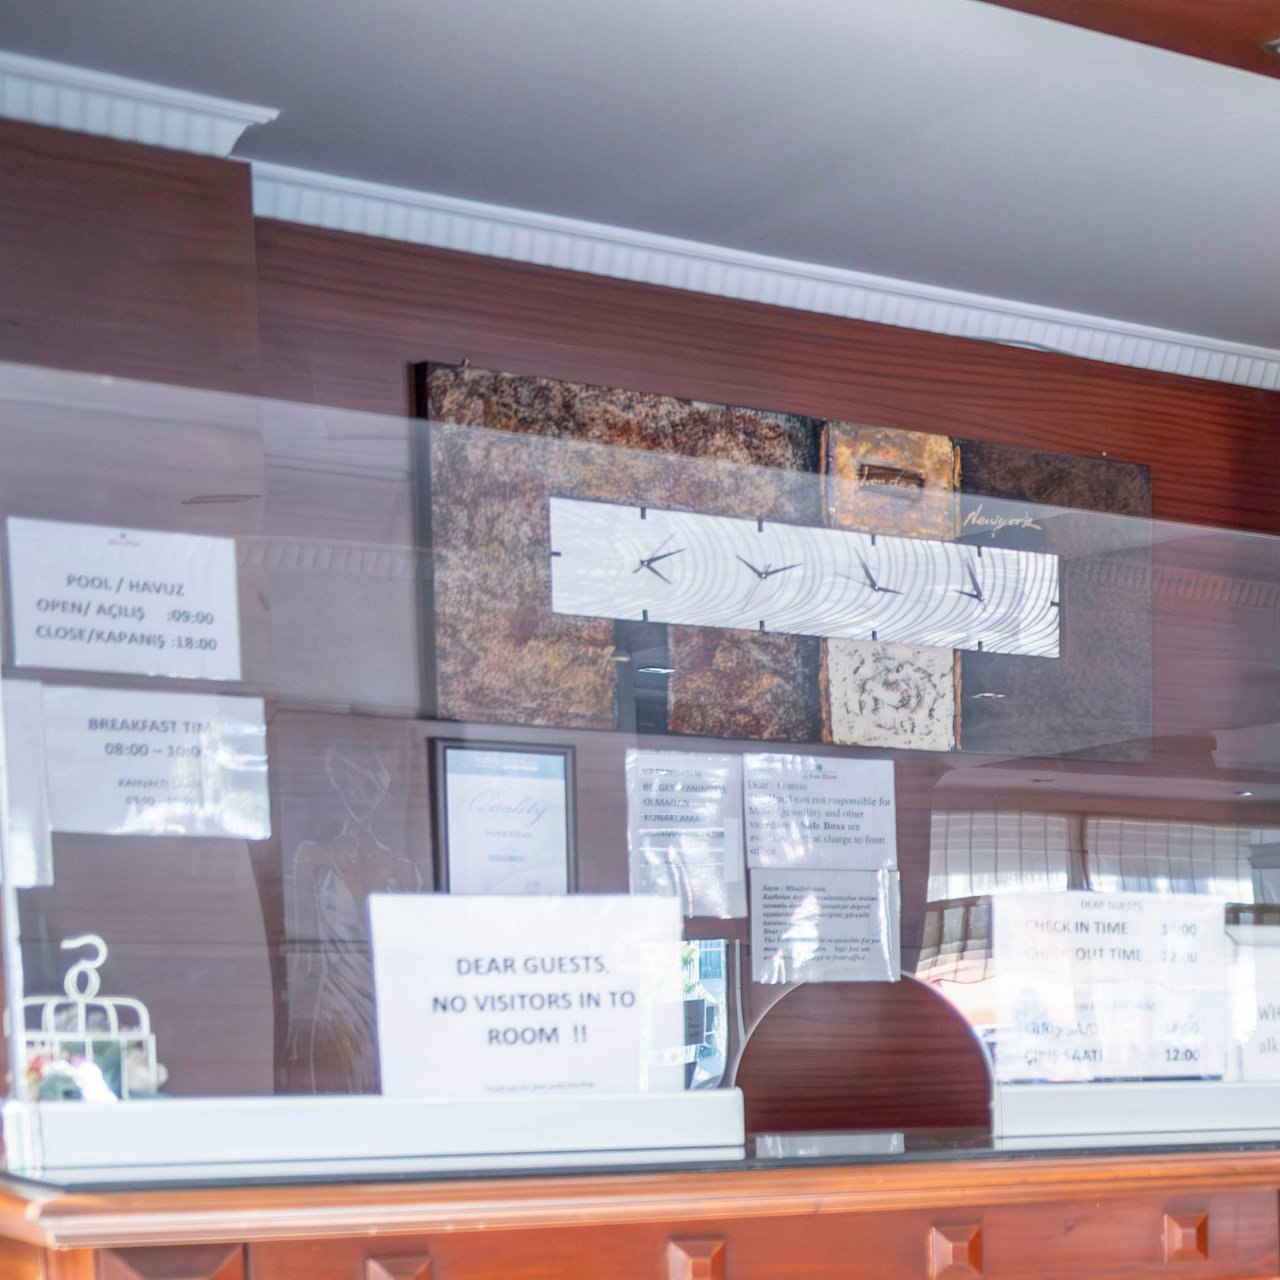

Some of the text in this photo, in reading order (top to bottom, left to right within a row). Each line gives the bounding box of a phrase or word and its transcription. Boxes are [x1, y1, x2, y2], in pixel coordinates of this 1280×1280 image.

[67, 574, 185, 596] POOL / HAVUZ
[36, 598, 215, 625] OPEN/ AÇILIŞ :09:00
[171, 636, 218, 651] :18:00
[88, 717, 177, 733] BREAKFAST
[104, 742, 149, 757] 08:00
[825, 808, 840, 818] and
[1075, 922, 1089, 934] IN
[1094, 922, 1129, 935] TIME
[1076, 948, 1104, 961] OUT
[1109, 948, 1143, 962] TIME
[456, 957, 516, 975] DEAR
[432, 990, 636, 1014] NO VISITORS IN TO
[487, 1025, 588, 1046] ROOM !!
